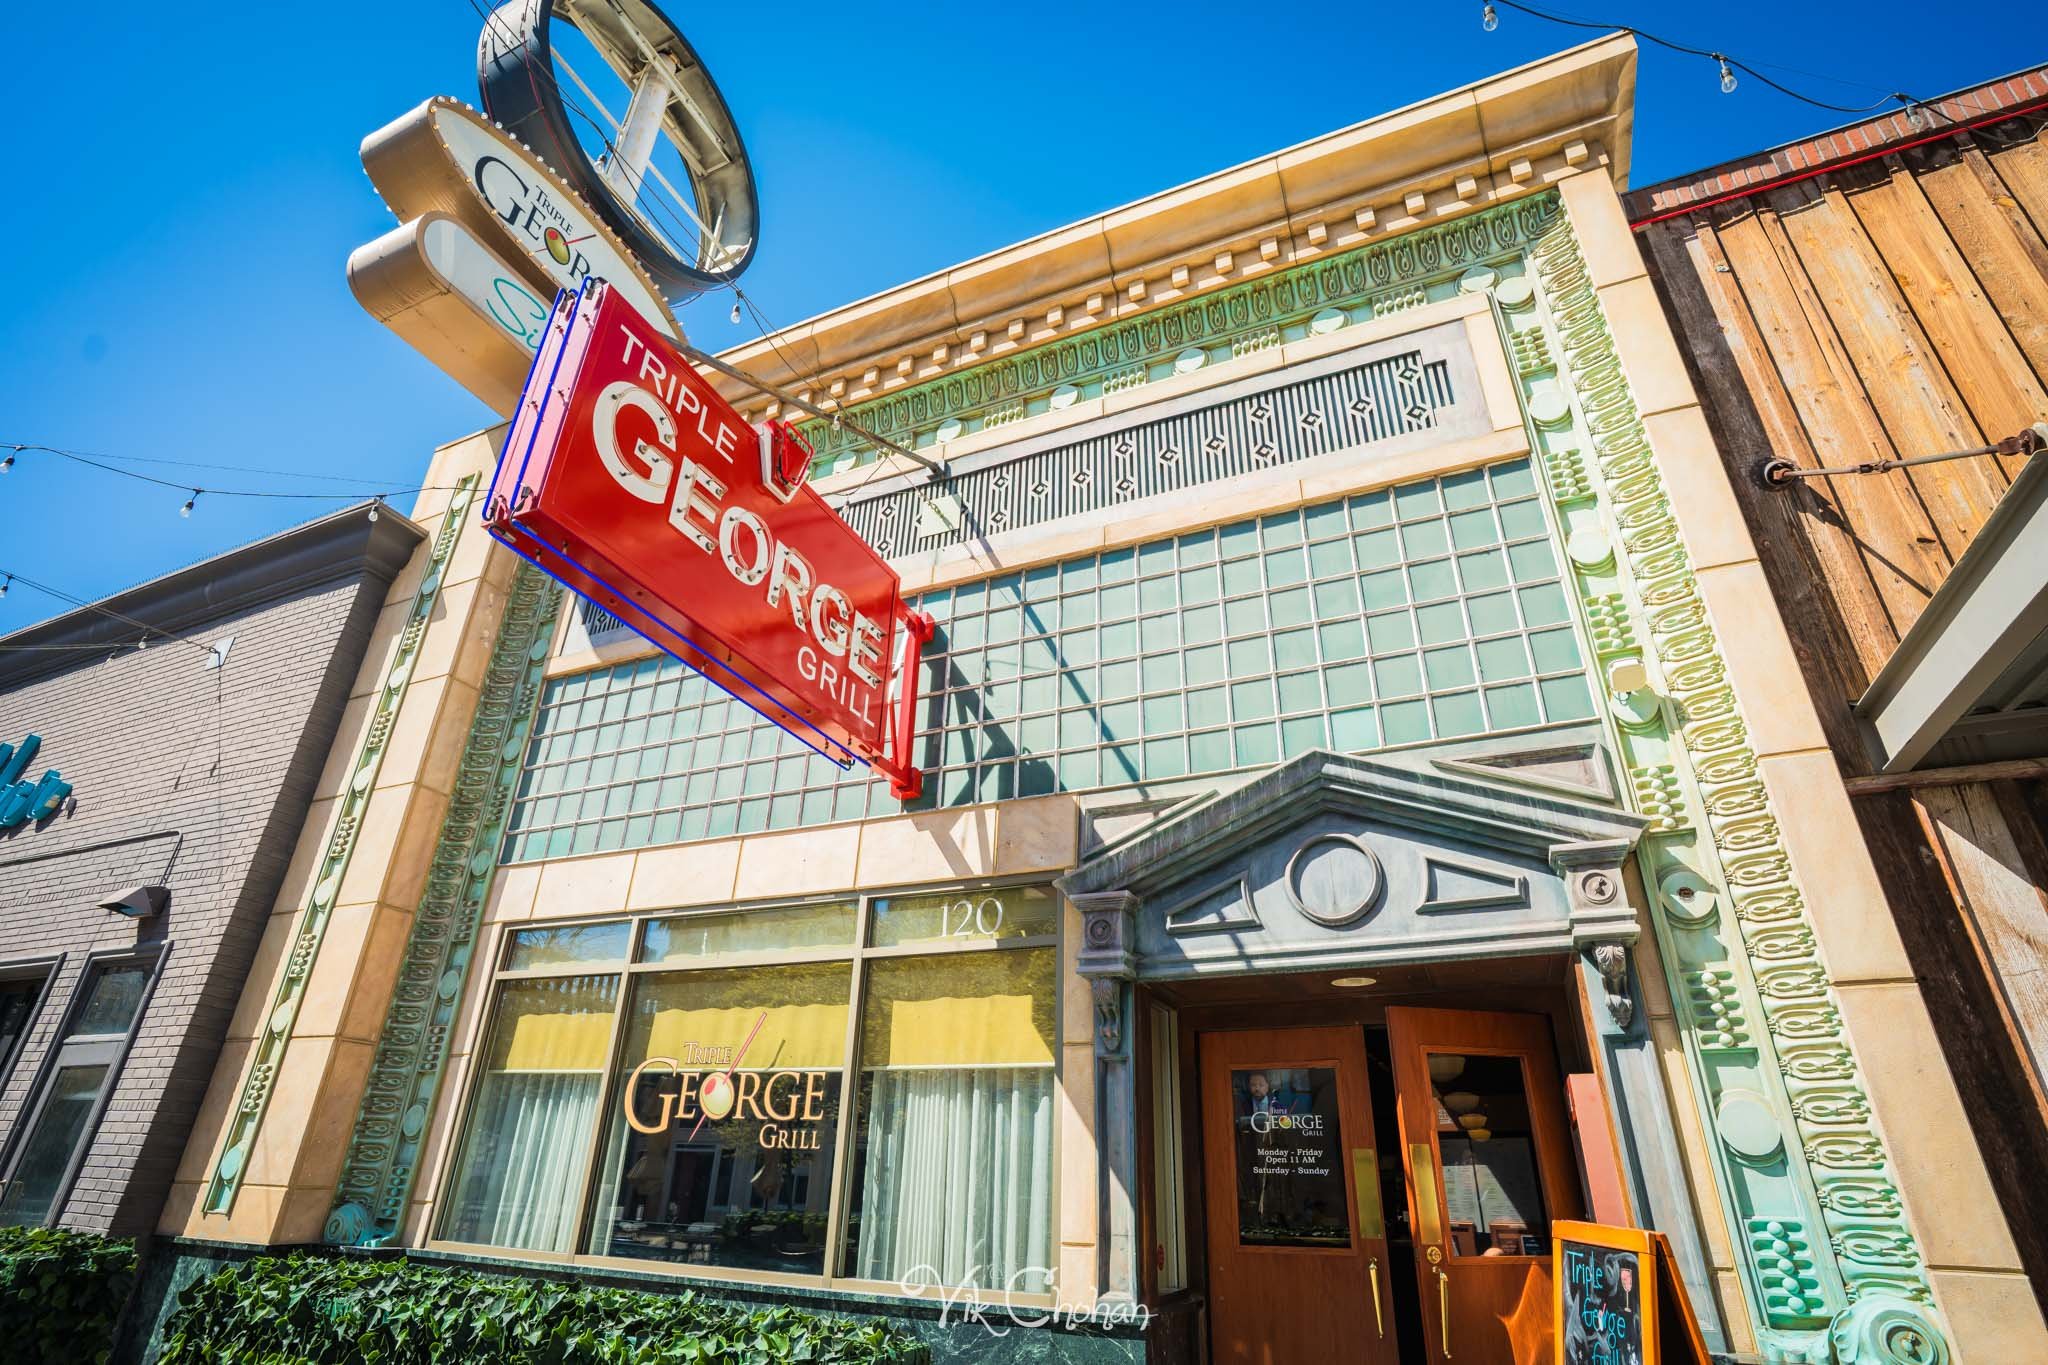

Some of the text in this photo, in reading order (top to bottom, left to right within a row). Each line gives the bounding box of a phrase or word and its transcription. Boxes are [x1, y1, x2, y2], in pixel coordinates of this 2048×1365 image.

[475, 156, 592, 281] GEOR
[535, 185, 574, 236] TRIPLE
[486, 278, 547, 350] Si
[619, 324, 738, 465] TRIPLE
[592, 381, 887, 689] GEORGE
[797, 646, 875, 728] GRILL
[940, 897, 1003, 937] 120
[684, 1041, 733, 1065] TRIPLE
[624, 1057, 826, 1134] GEORGE
[759, 1123, 821, 1149] GRILL
[1250, 1111, 1324, 1134] GEORGE
[1253, 1166, 1290, 1176] Saturday
[1298, 1167, 1330, 1176] Sunday
[1257, 1148, 1289, 1157] Monday
[1296, 1148, 1324, 1157] Friday
[1265, 1156, 1288, 1164] Open
[1302, 1156, 1316, 1164] AM
[1567, 1250, 1604, 1296] Triple
[1582, 1298, 1626, 1349] George
